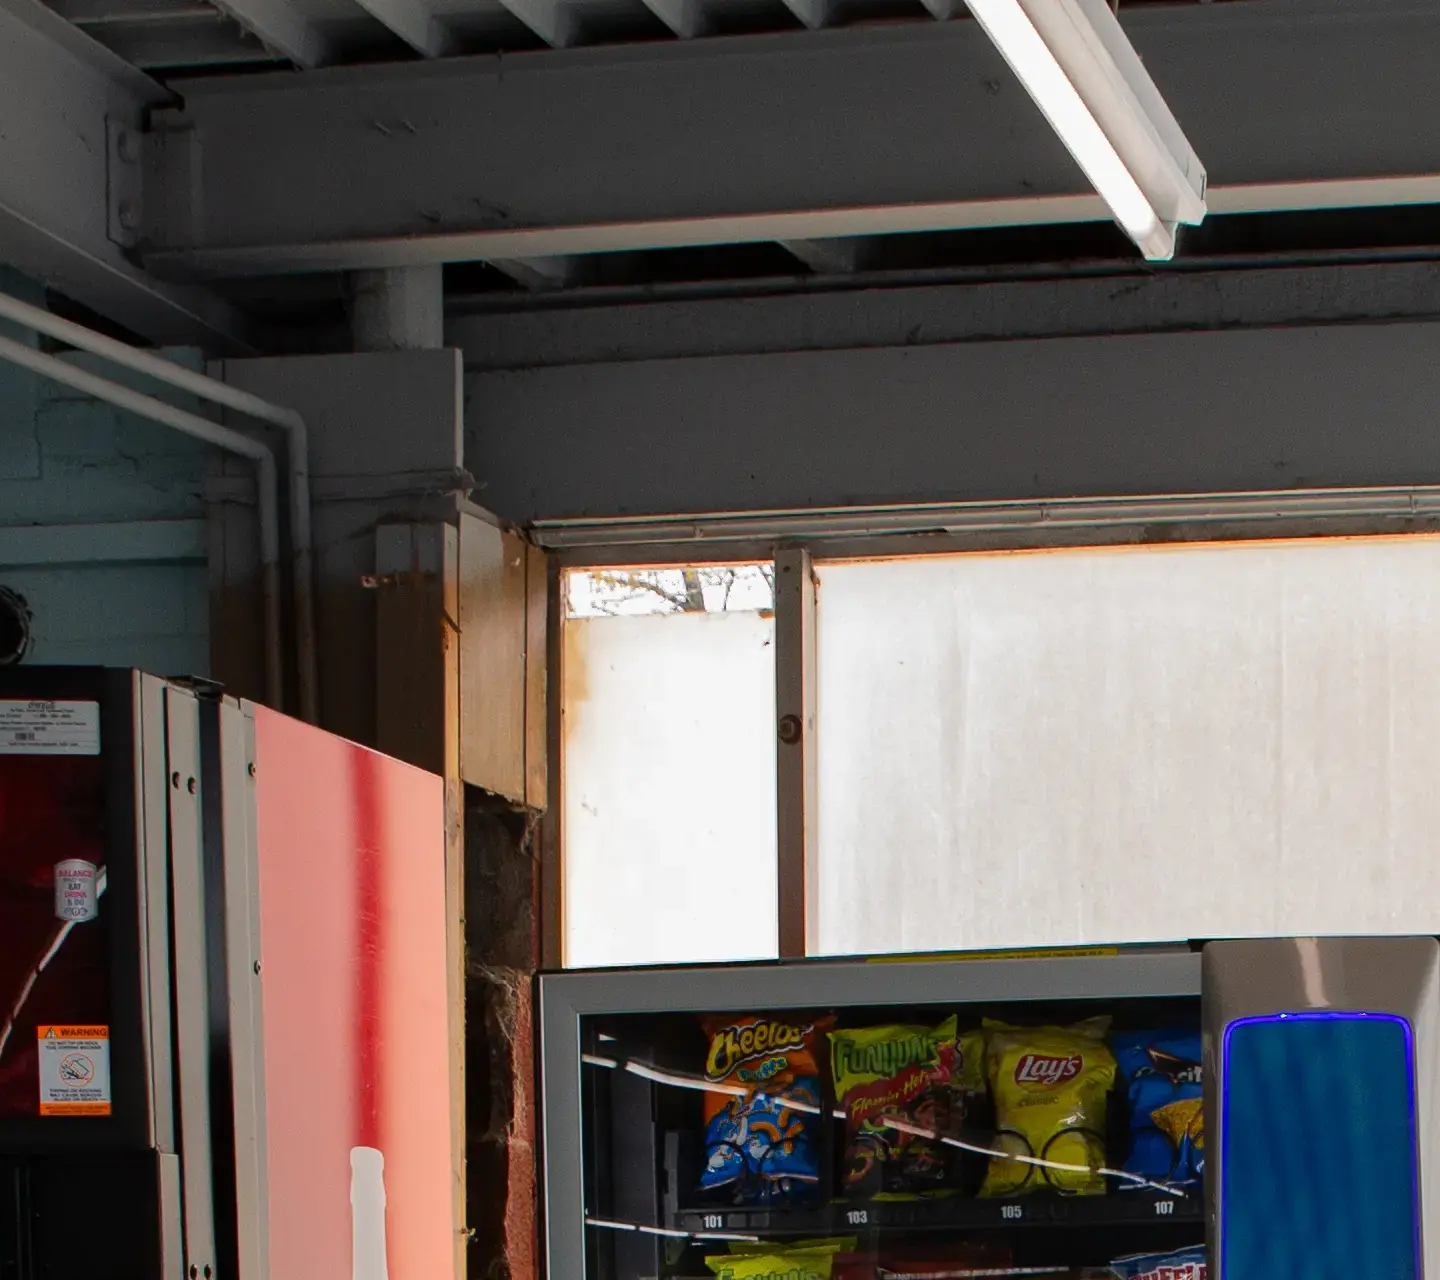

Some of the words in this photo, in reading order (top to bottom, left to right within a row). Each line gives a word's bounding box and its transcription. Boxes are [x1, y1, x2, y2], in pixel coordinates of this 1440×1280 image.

[61, 1028, 107, 1036] WARNING
[705, 1020, 814, 1082] Cheetos
[1017, 1055, 1082, 1085] Lay's
[1000, 1205, 1022, 1219] 105
[1154, 1201, 1174, 1215] 107
[704, 1215, 723, 1228] 101
[847, 1210, 868, 1224] 103
